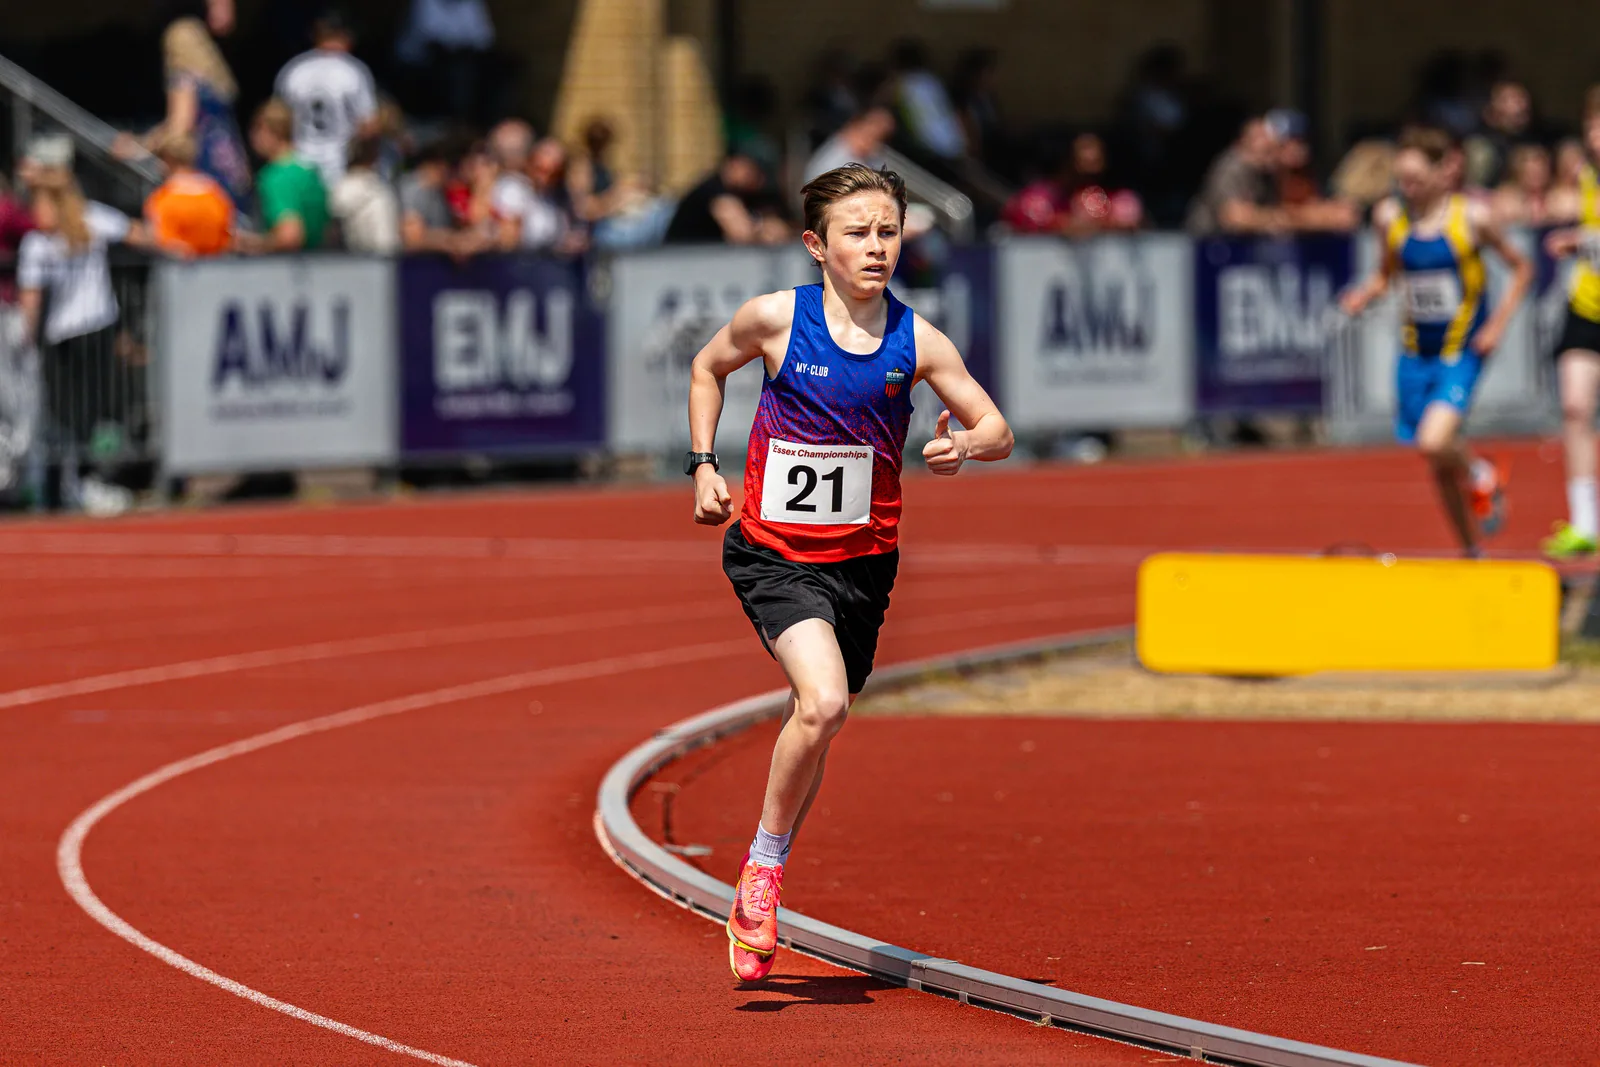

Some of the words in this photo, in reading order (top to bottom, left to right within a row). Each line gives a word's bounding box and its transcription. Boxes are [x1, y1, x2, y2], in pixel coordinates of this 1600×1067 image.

[211, 297, 352, 393] AMJ
[773, 444, 796, 457] Essex
[797, 449, 868, 460] Championships
[785, 464, 844, 513] 21
